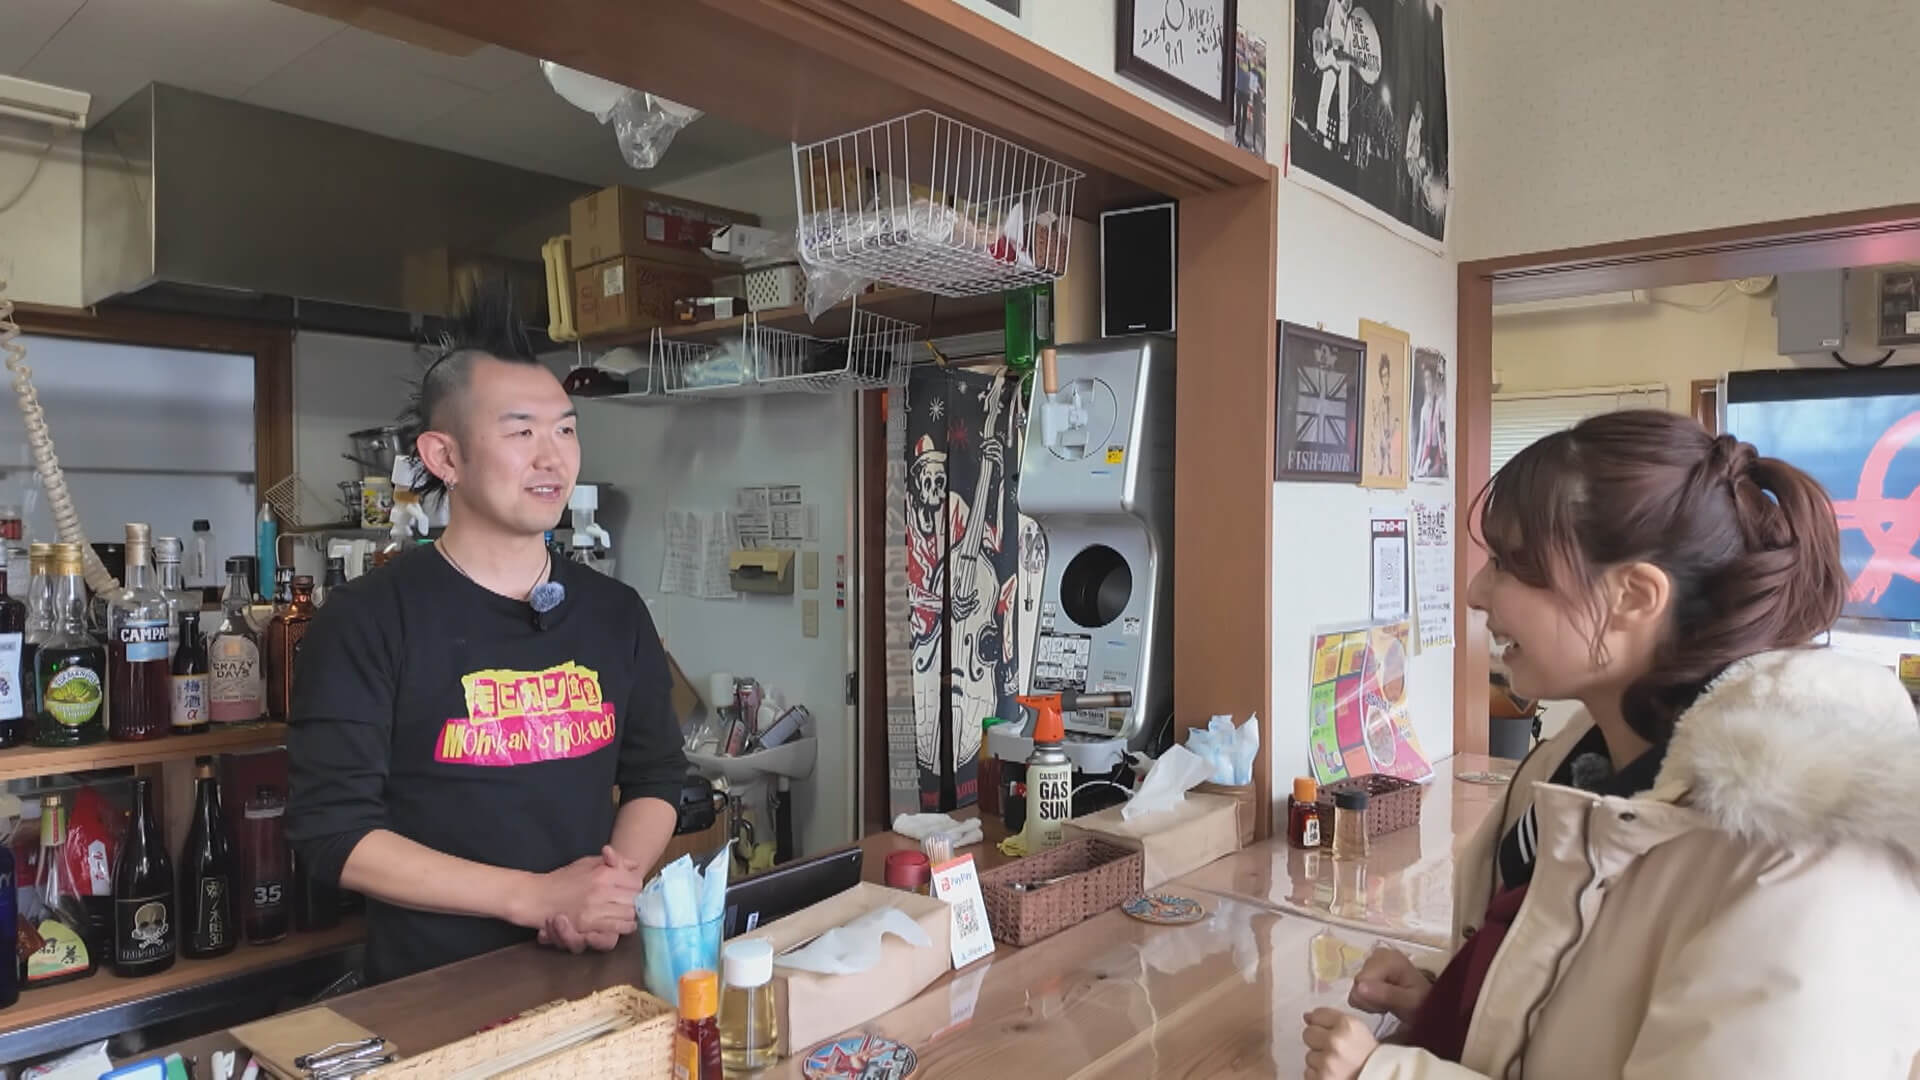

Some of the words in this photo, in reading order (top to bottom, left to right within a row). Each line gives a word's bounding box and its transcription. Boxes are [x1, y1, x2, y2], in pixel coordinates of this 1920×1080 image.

[1040, 781, 1069, 800] GAS
[1040, 801, 1069, 820] SUN
[254, 884, 282, 904] 35
